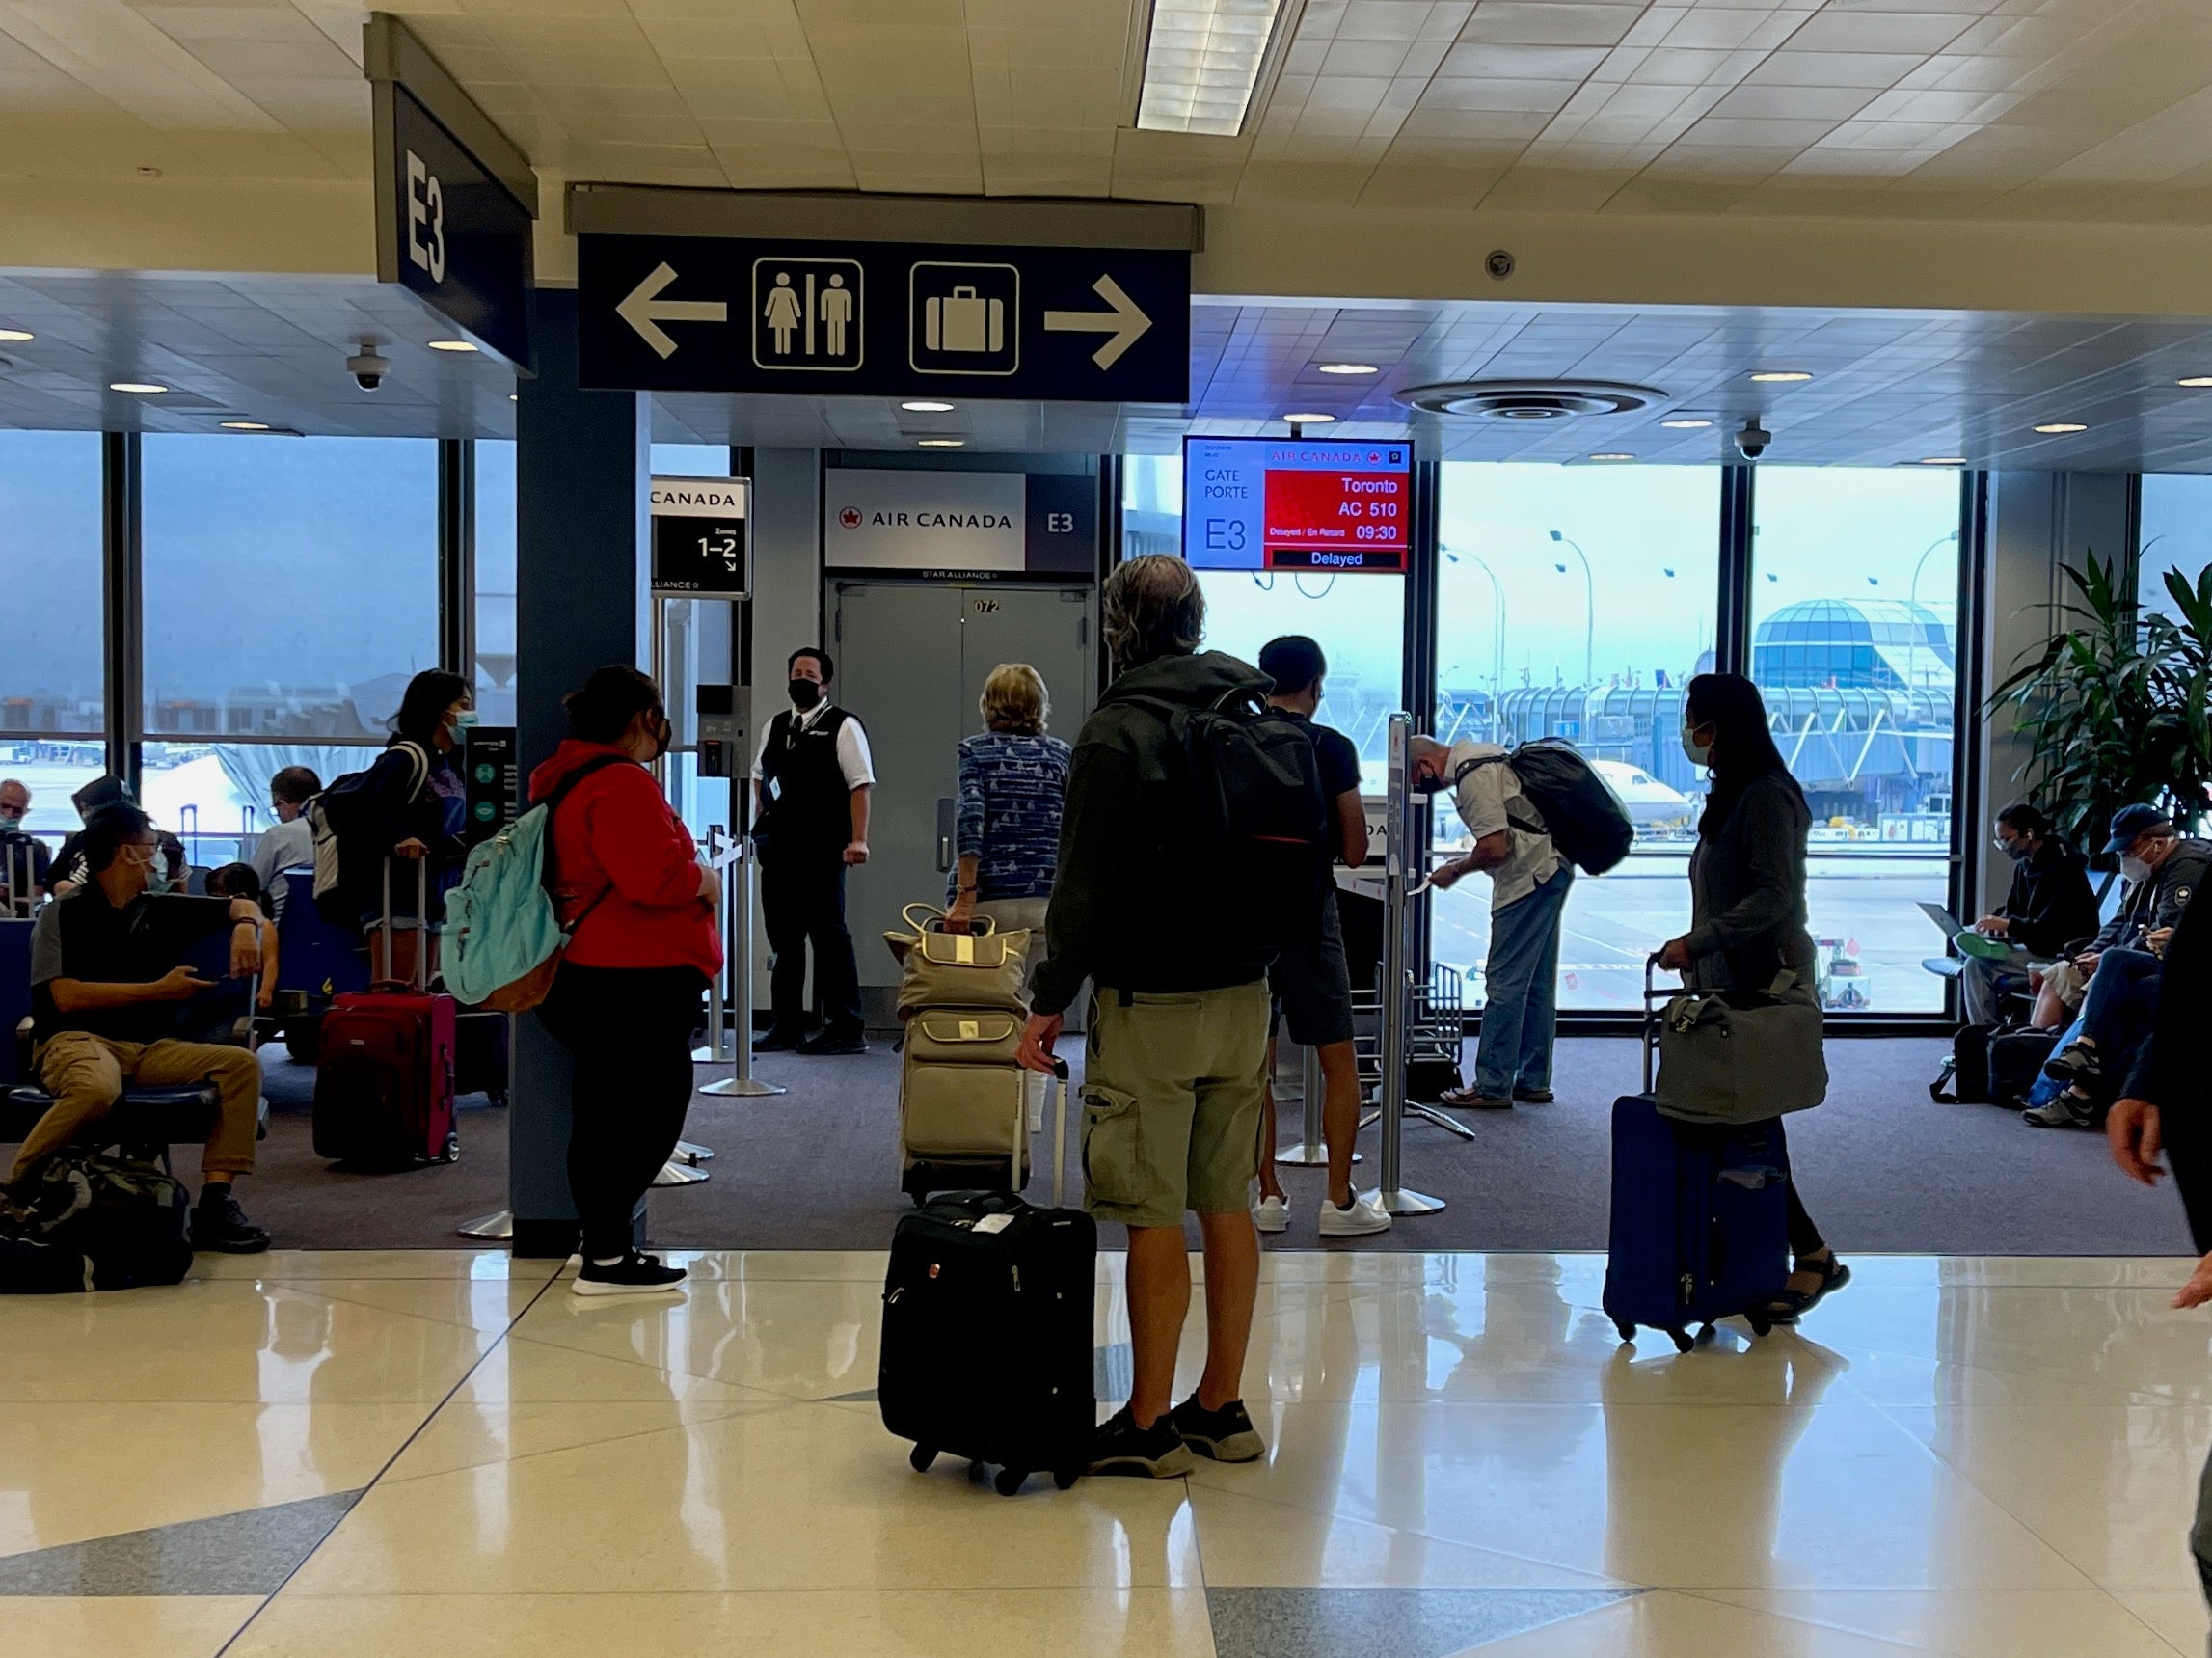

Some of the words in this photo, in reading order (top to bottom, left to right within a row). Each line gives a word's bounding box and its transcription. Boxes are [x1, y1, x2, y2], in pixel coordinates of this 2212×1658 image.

[407, 149, 445, 284] E3
[1272, 451, 1295, 461] AIR
[1300, 451, 1362, 463] CANADA
[1205, 469, 1239, 482] GATE
[1205, 485, 1248, 499] PORTE
[1341, 478, 1397, 494] Toronto
[651, 491, 735, 506] CANADA
[1339, 502, 1362, 516] AC
[1369, 502, 1397, 516] 510
[872, 512, 909, 526] AIR
[916, 513, 1012, 529] CANADA
[1047, 513, 1073, 532] E3
[1206, 518, 1246, 550] E3
[1269, 527, 1301, 537] Delayed
[1307, 528, 1317, 536] En
[1356, 525, 1396, 539] 09:30
[1311, 552, 1362, 567] Delayed
[974, 600, 999, 612] 072
